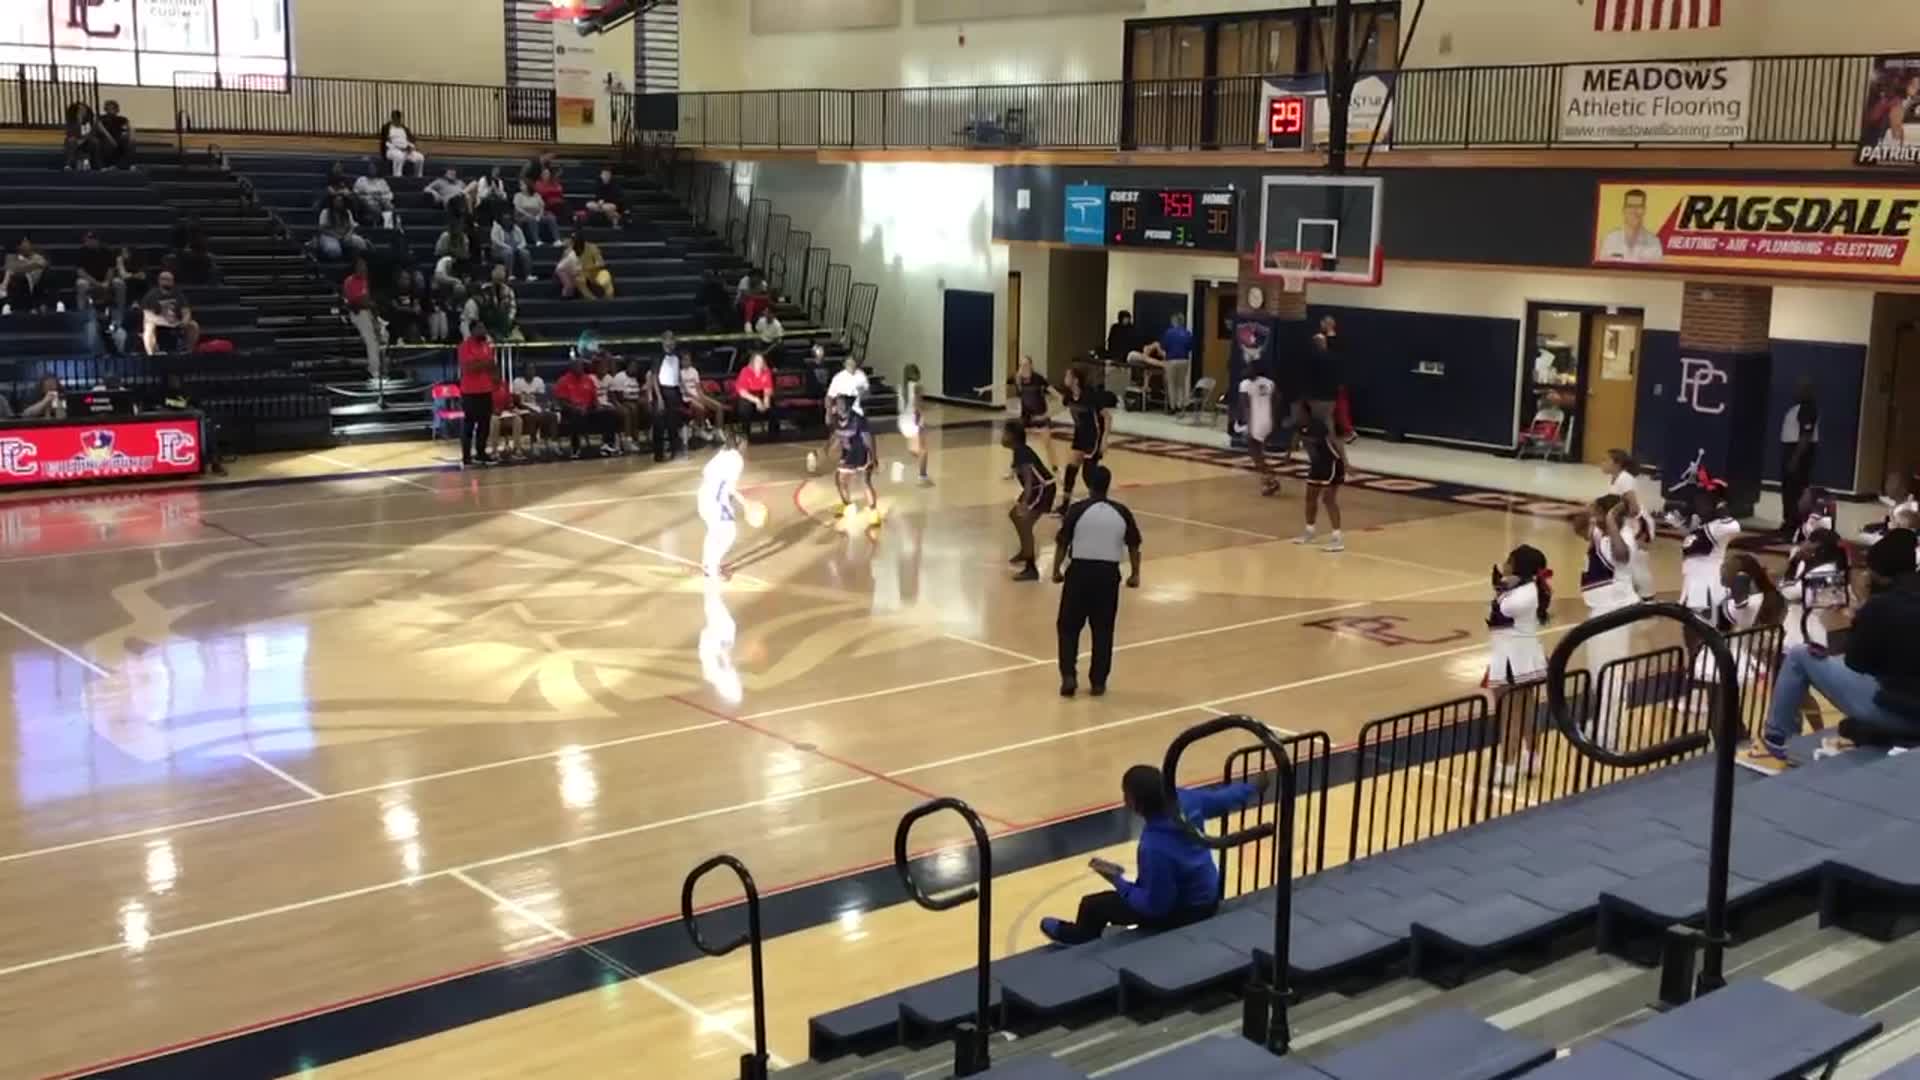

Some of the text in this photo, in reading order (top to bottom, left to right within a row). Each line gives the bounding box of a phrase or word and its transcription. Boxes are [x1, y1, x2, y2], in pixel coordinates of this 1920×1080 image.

[1582, 67, 1728, 92] MEADOWS
[1271, 101, 1301, 133] 29
[1568, 96, 1741, 120] Athletic Flooring
[1110, 191, 1140, 203] GUEST
[1202, 193, 1233, 205] HOME
[1677, 194, 1920, 236] RAGSDALE
[1667, 235, 1898, 259] HEATING AIR PLUMBING ELECTRIC
[155, 428, 196, 465] PC
